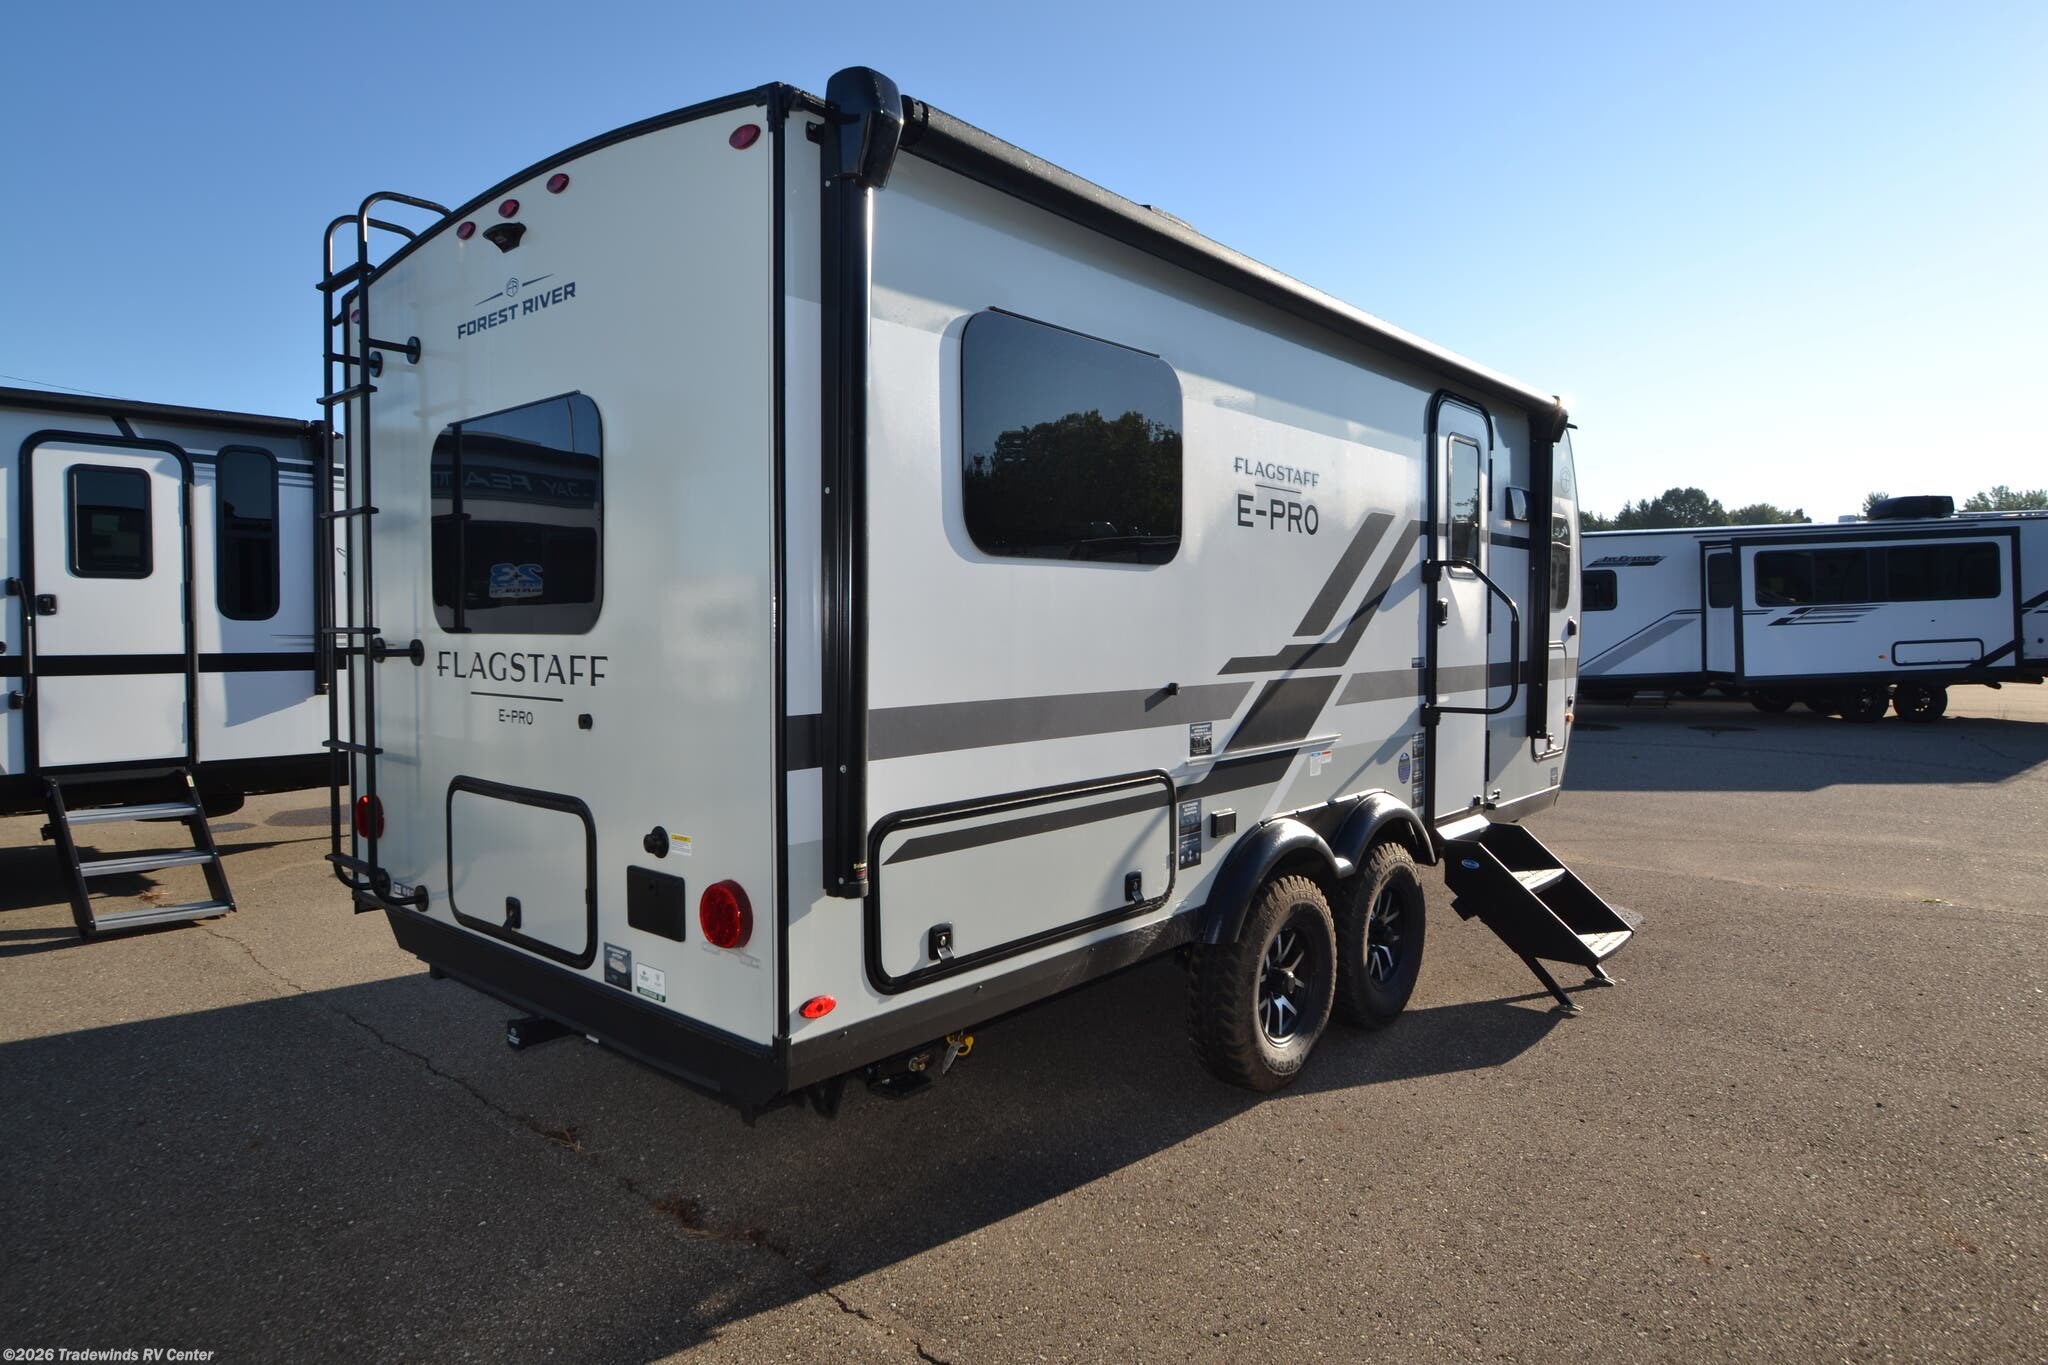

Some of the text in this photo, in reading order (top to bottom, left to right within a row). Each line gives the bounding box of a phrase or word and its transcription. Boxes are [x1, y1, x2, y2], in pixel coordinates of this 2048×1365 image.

[457, 281, 576, 340] FOREST RIVER
[1233, 456, 1320, 488] FLAGSTAFF
[1237, 493, 1319, 536] E-PRO
[437, 651, 609, 687] FLAGSTAFF
[498, 708, 534, 726] E-PRO
